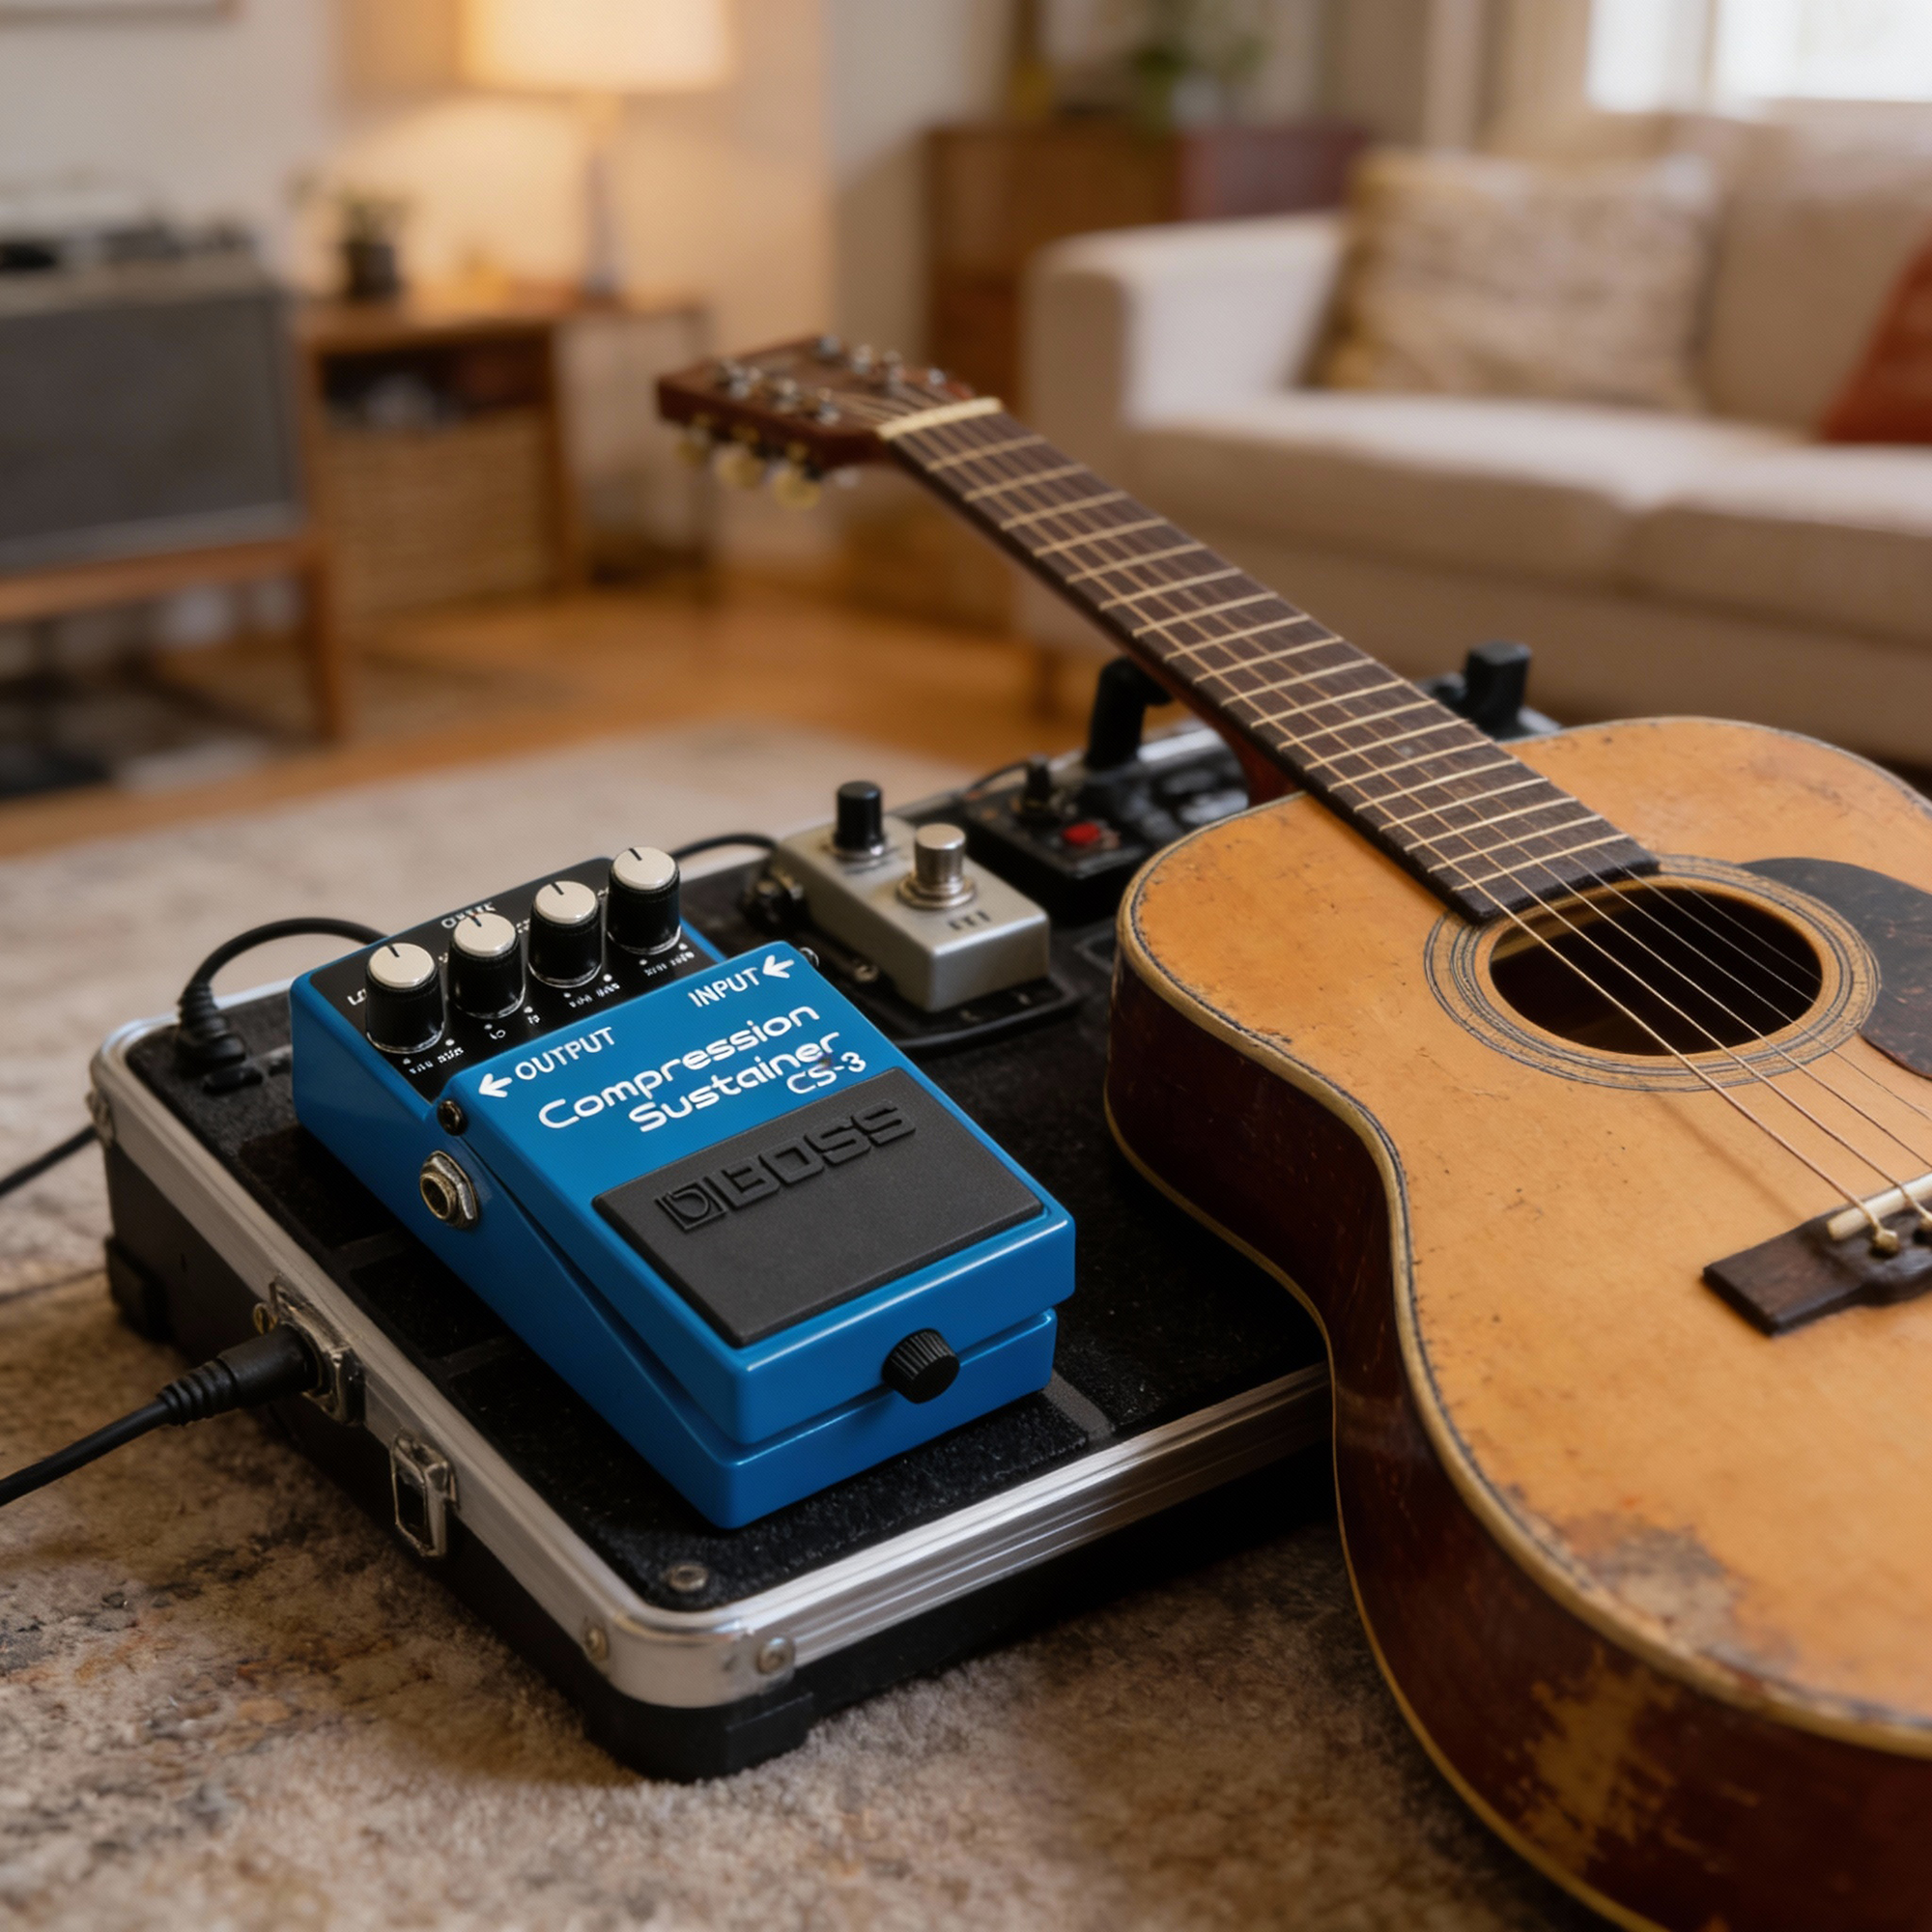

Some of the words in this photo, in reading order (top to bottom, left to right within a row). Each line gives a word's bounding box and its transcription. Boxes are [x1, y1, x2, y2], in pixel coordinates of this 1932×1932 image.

[687, 967, 760, 1008] INPUT
[515, 1026, 615, 1081] OUTPUT
[538, 1006, 820, 1129] Compression
[628, 1032, 839, 1132] Sustainer
[786, 1052, 867, 1094] CS-3
[707, 1099, 916, 1211] BOSS
